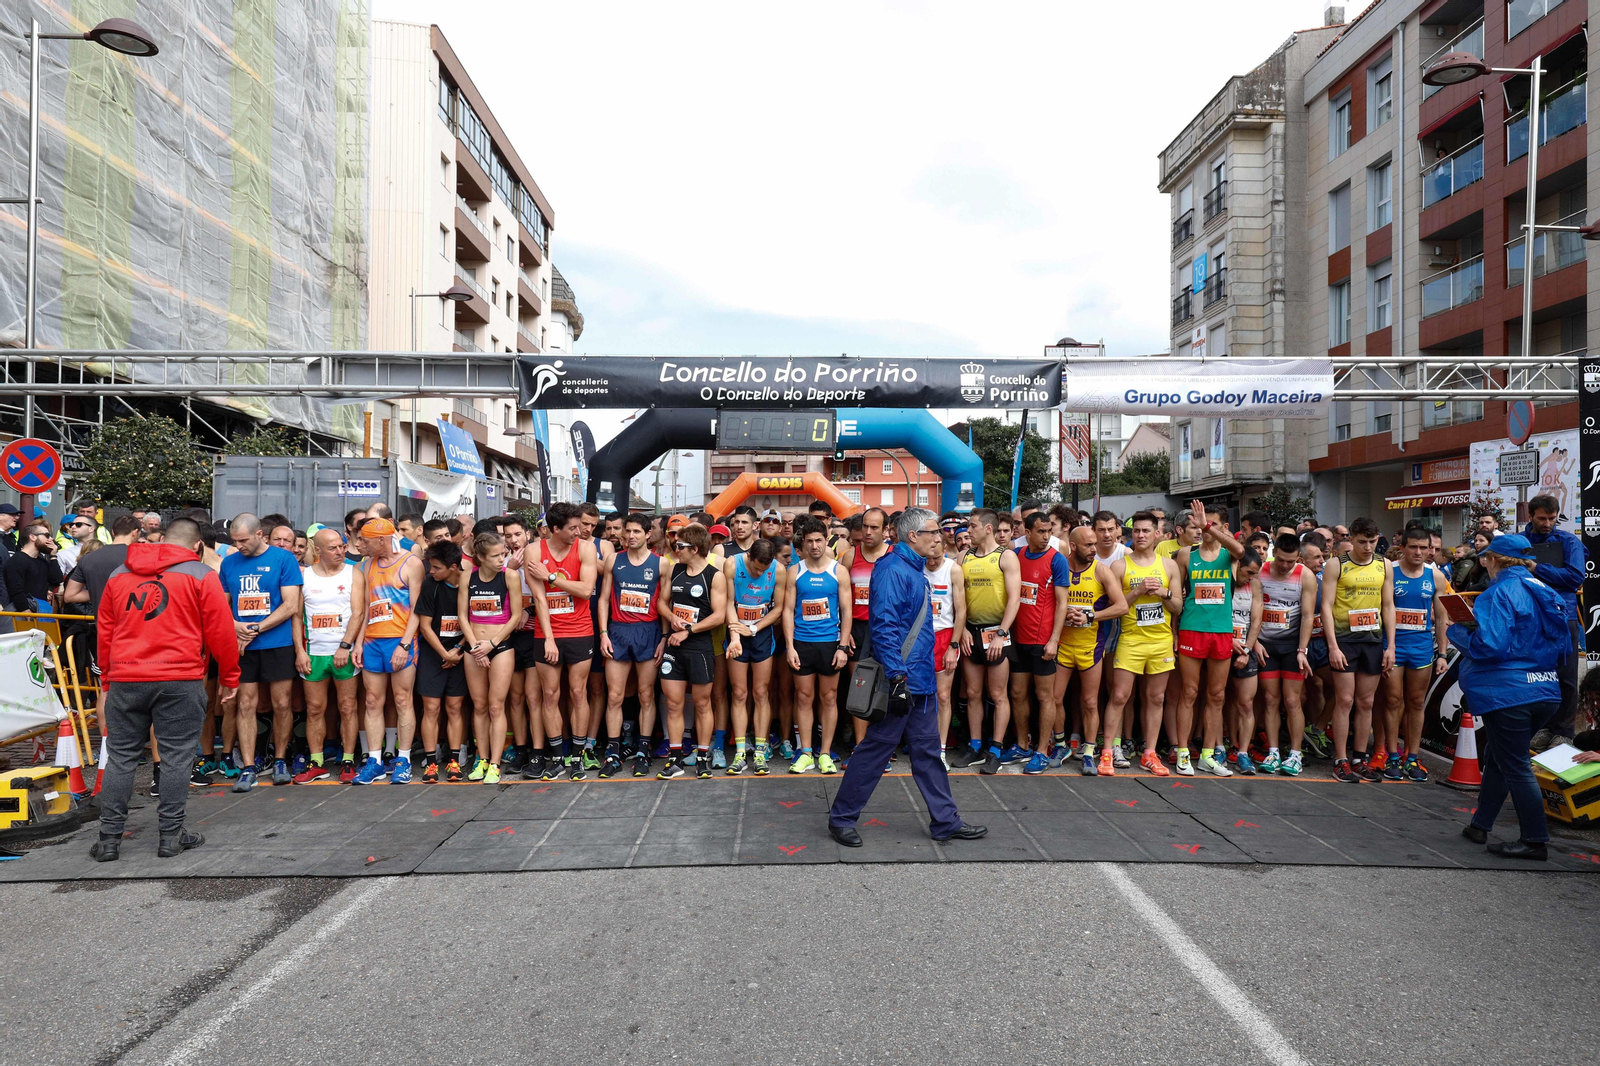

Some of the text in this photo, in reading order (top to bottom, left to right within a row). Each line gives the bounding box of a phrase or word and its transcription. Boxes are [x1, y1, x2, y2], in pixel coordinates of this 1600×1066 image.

[660, 361, 918, 383] Concello do Porriño
[562, 378, 609, 386] concellería
[989, 374, 1046, 386] Concello do
[562, 387, 609, 396] de deportes
[701, 386, 866, 404] O Concello do Deporte
[990, 387, 1049, 401] Porriño
[1124, 389, 1322, 407] Grupo Godoy Maceira
[1429, 460, 1458, 472] CENTRO
[759, 477, 802, 489] GADIS
[1387, 494, 1471, 510] Carril 32 AUTOESC
[1191, 569, 1230, 580] BIKILA
[239, 576, 261, 591] 10K
[1201, 589, 1218, 599] 824
[243, 599, 260, 611] 237
[476, 602, 492, 611] 387
[806, 605, 822, 616] 998
[743, 611, 757, 621] 910
[1141, 610, 1160, 621] 1822
[1266, 613, 1280, 623] 919
[1357, 615, 1372, 626] 921
[1401, 615, 1419, 625] 829
[317, 617, 333, 629] 767
